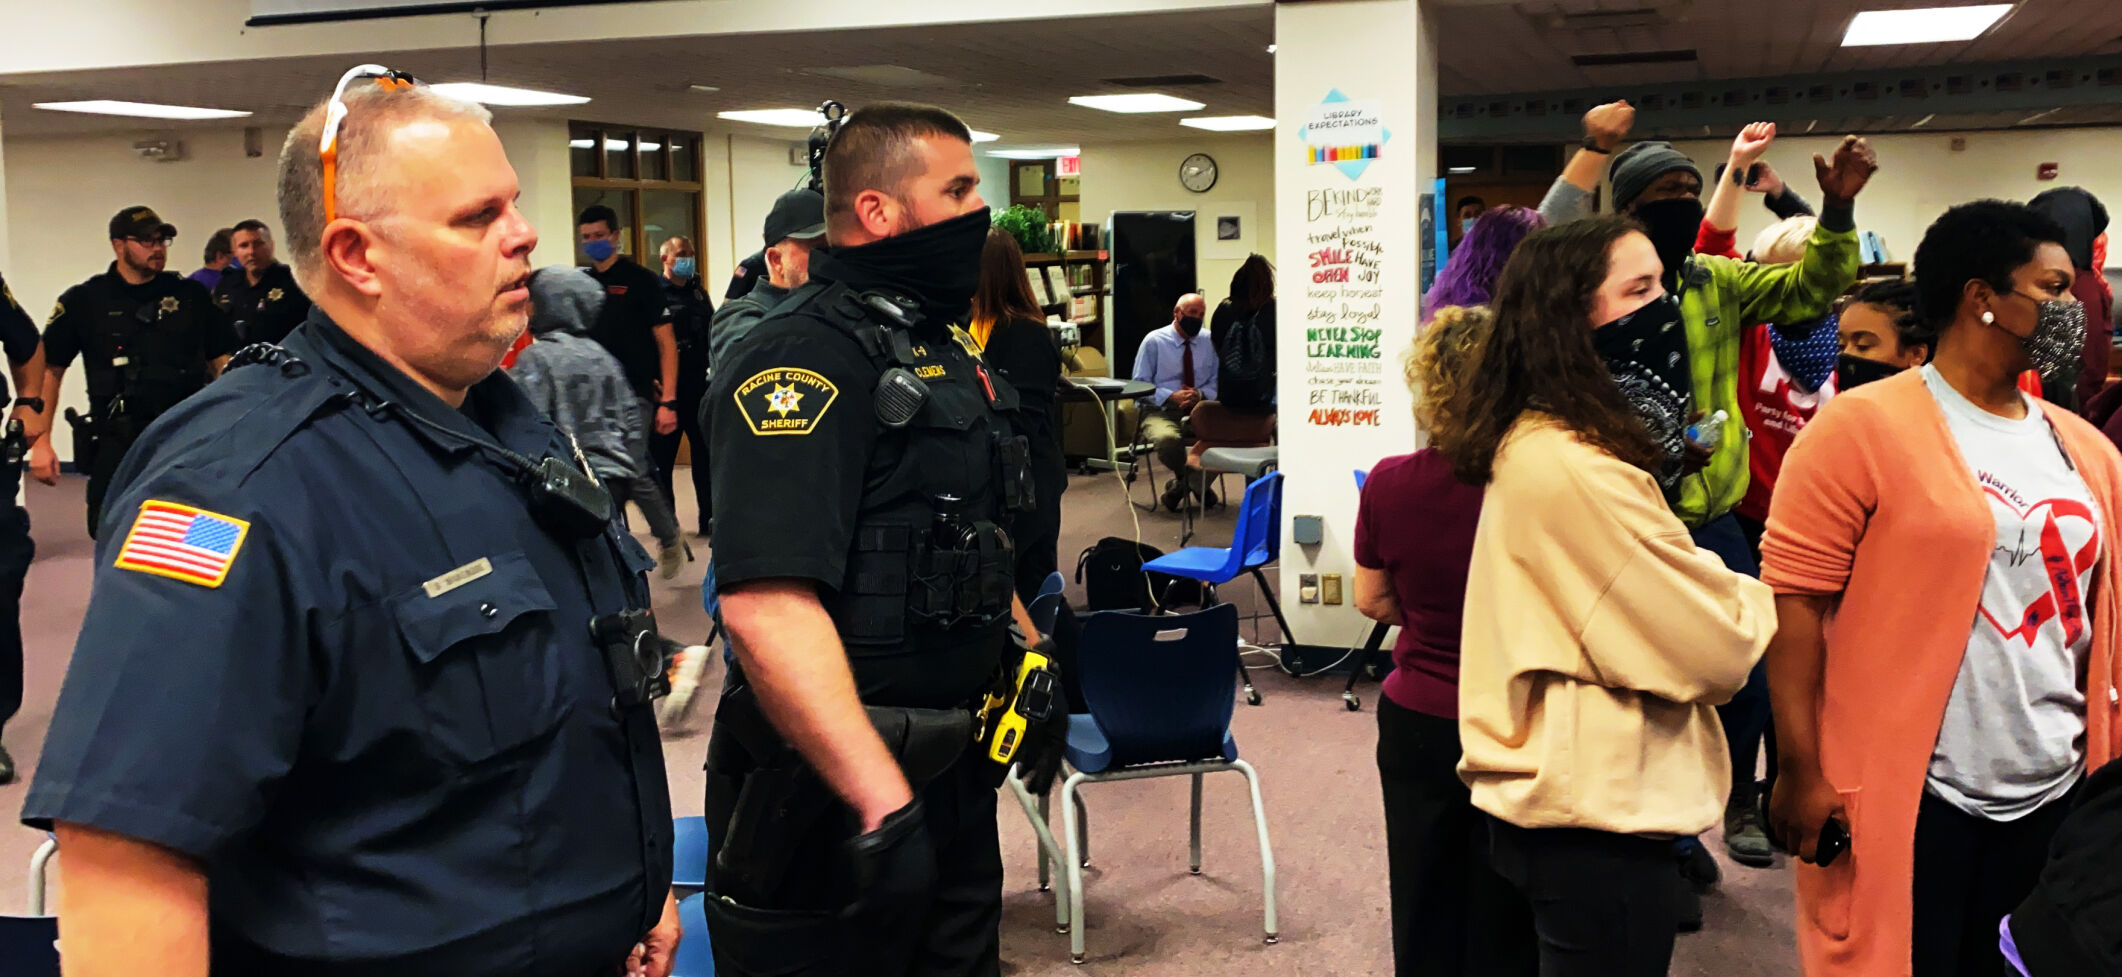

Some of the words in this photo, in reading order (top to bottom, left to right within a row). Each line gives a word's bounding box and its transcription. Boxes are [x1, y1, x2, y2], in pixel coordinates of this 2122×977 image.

[1324, 110, 1362, 119] LIBRARY
[1308, 117, 1378, 130] EXPECTATIONS
[1307, 225, 1341, 244] travel
[1308, 247, 1354, 268] SMILE
[1358, 269, 1380, 284] JOY
[1307, 285, 1337, 303] keep
[1341, 285, 1383, 299] honest
[1307, 306, 1336, 324] stay
[1341, 302, 1381, 324] loyal
[1307, 327, 1347, 342] NEVER
[1307, 343, 1382, 358] LEARNING
[741, 373, 781, 396] RACINE
[785, 372, 830, 392] COUNTY
[1310, 389, 1328, 405] BE
[1332, 389, 1382, 405] THANKFUL
[1308, 408, 1350, 426] ALWAYS
[1353, 409, 1381, 426] LOVE
[1755, 402, 1781, 419] Party
[761, 419, 809, 429] SHERIFF
[1978, 469, 2029, 508] Warrior
